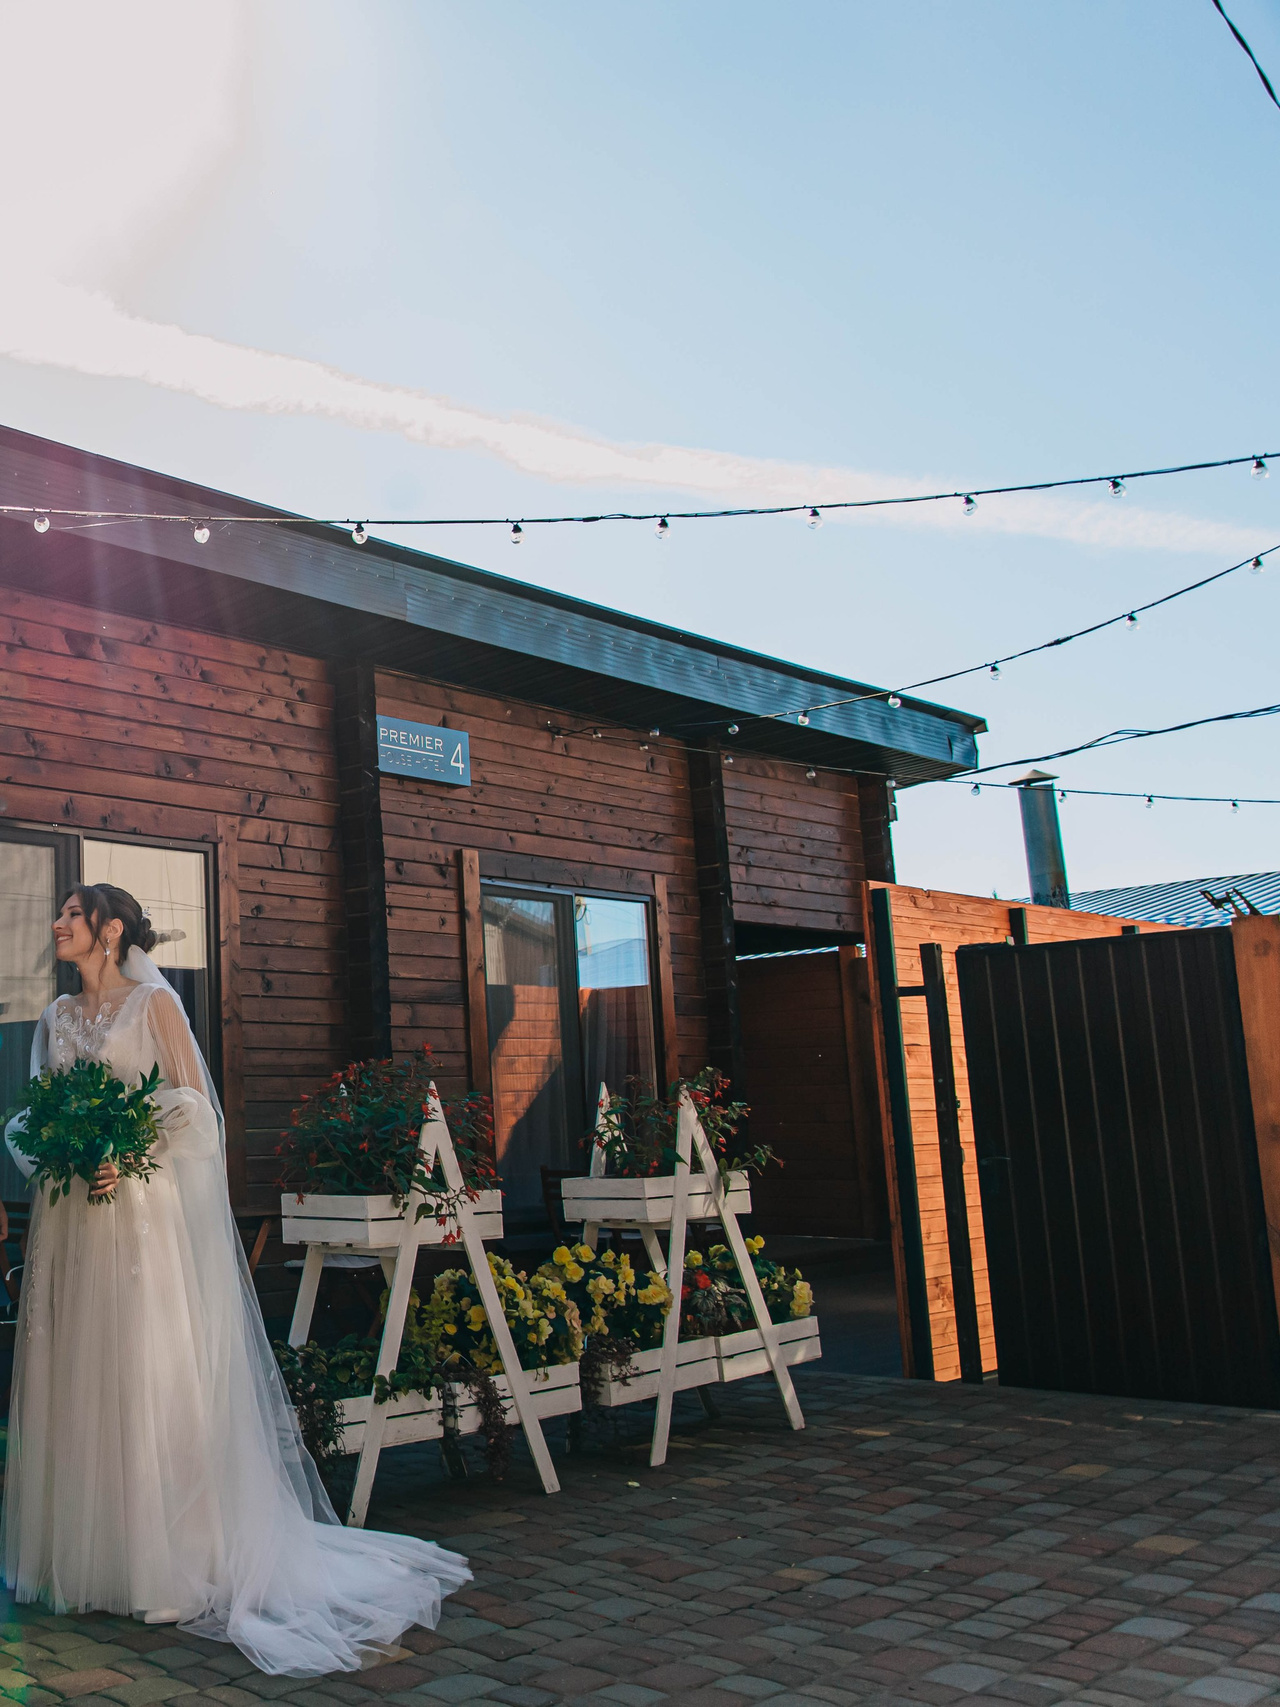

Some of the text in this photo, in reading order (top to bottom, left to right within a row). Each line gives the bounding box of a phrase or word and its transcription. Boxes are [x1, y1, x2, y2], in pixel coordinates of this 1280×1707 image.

[380, 727, 443, 751] PREMIER
[380, 750, 413, 767] OSE
[450, 742, 465, 775] 4
